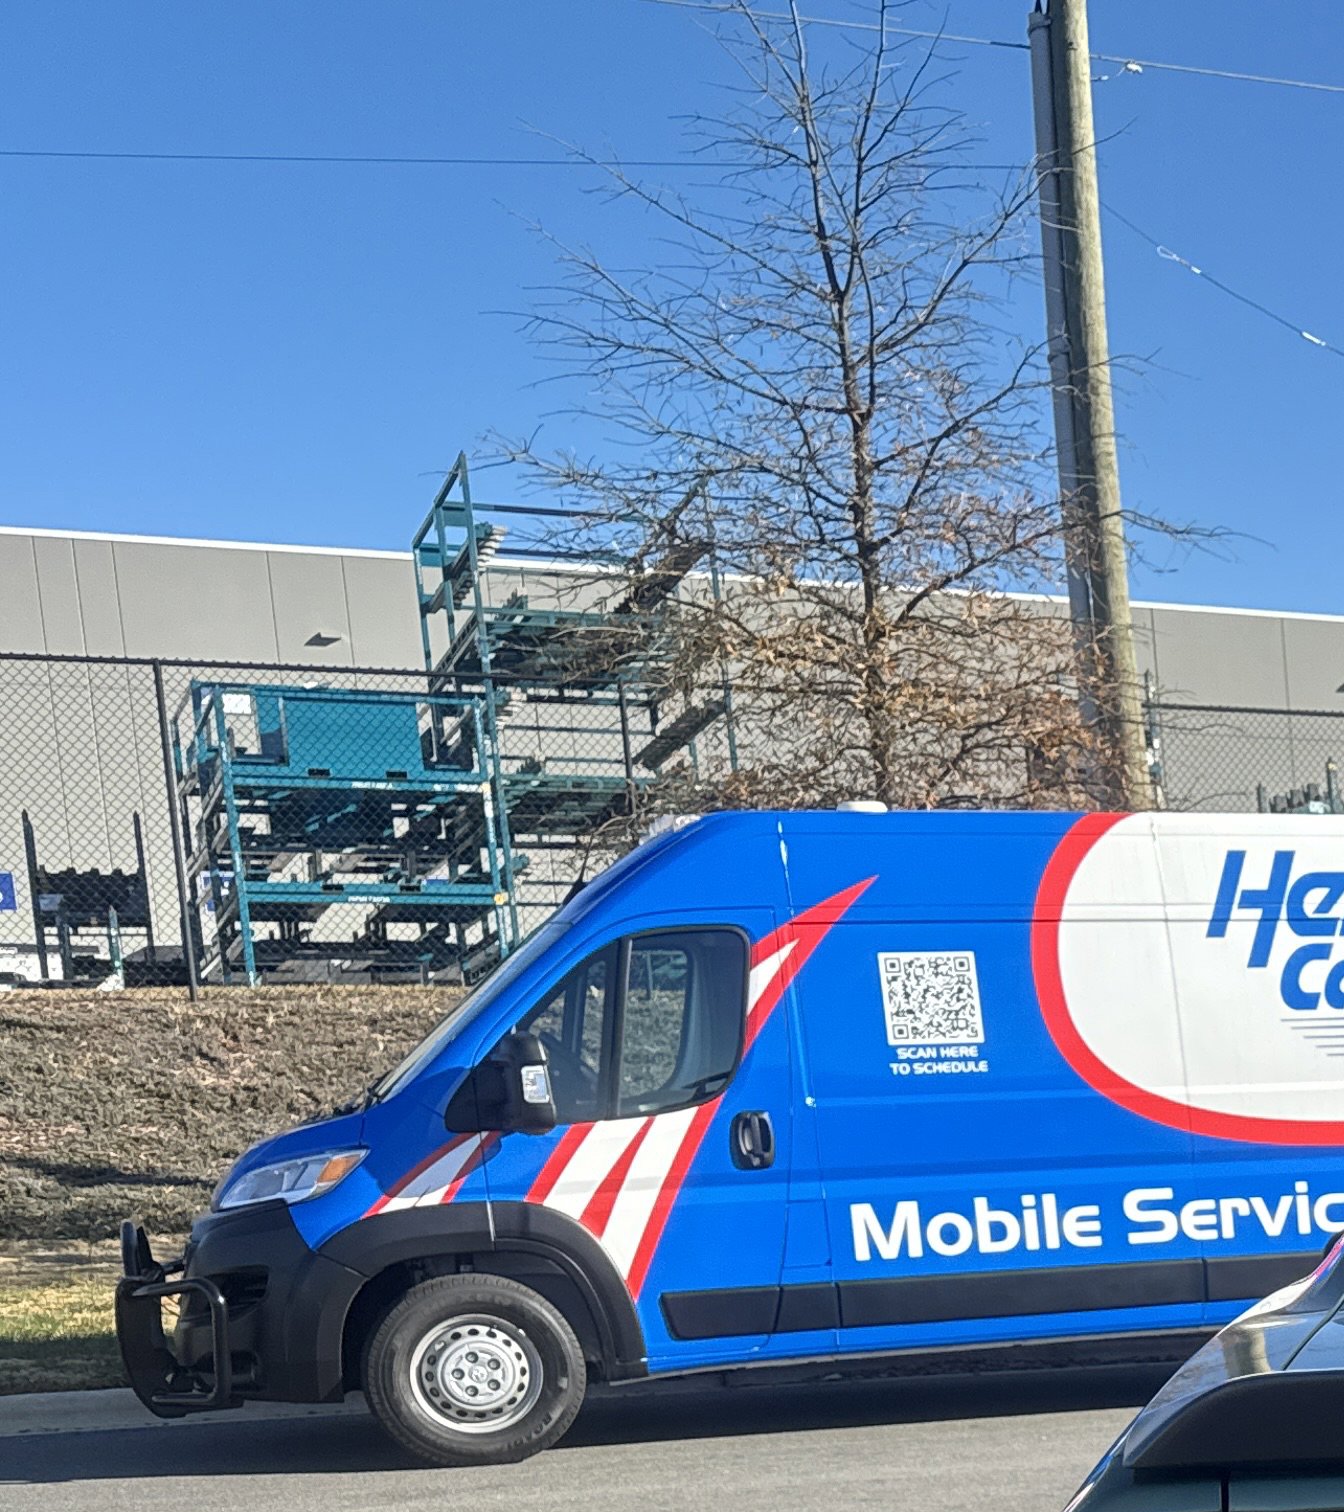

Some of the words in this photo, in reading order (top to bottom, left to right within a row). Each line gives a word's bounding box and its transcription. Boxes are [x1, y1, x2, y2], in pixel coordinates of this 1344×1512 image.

[896, 1047, 937, 1060] SCAN
[940, 1046, 979, 1058] HERE
[889, 1062, 911, 1075] TO
[912, 1060, 989, 1074] SCHEDULE
[850, 1193, 1103, 1262] Mobile
